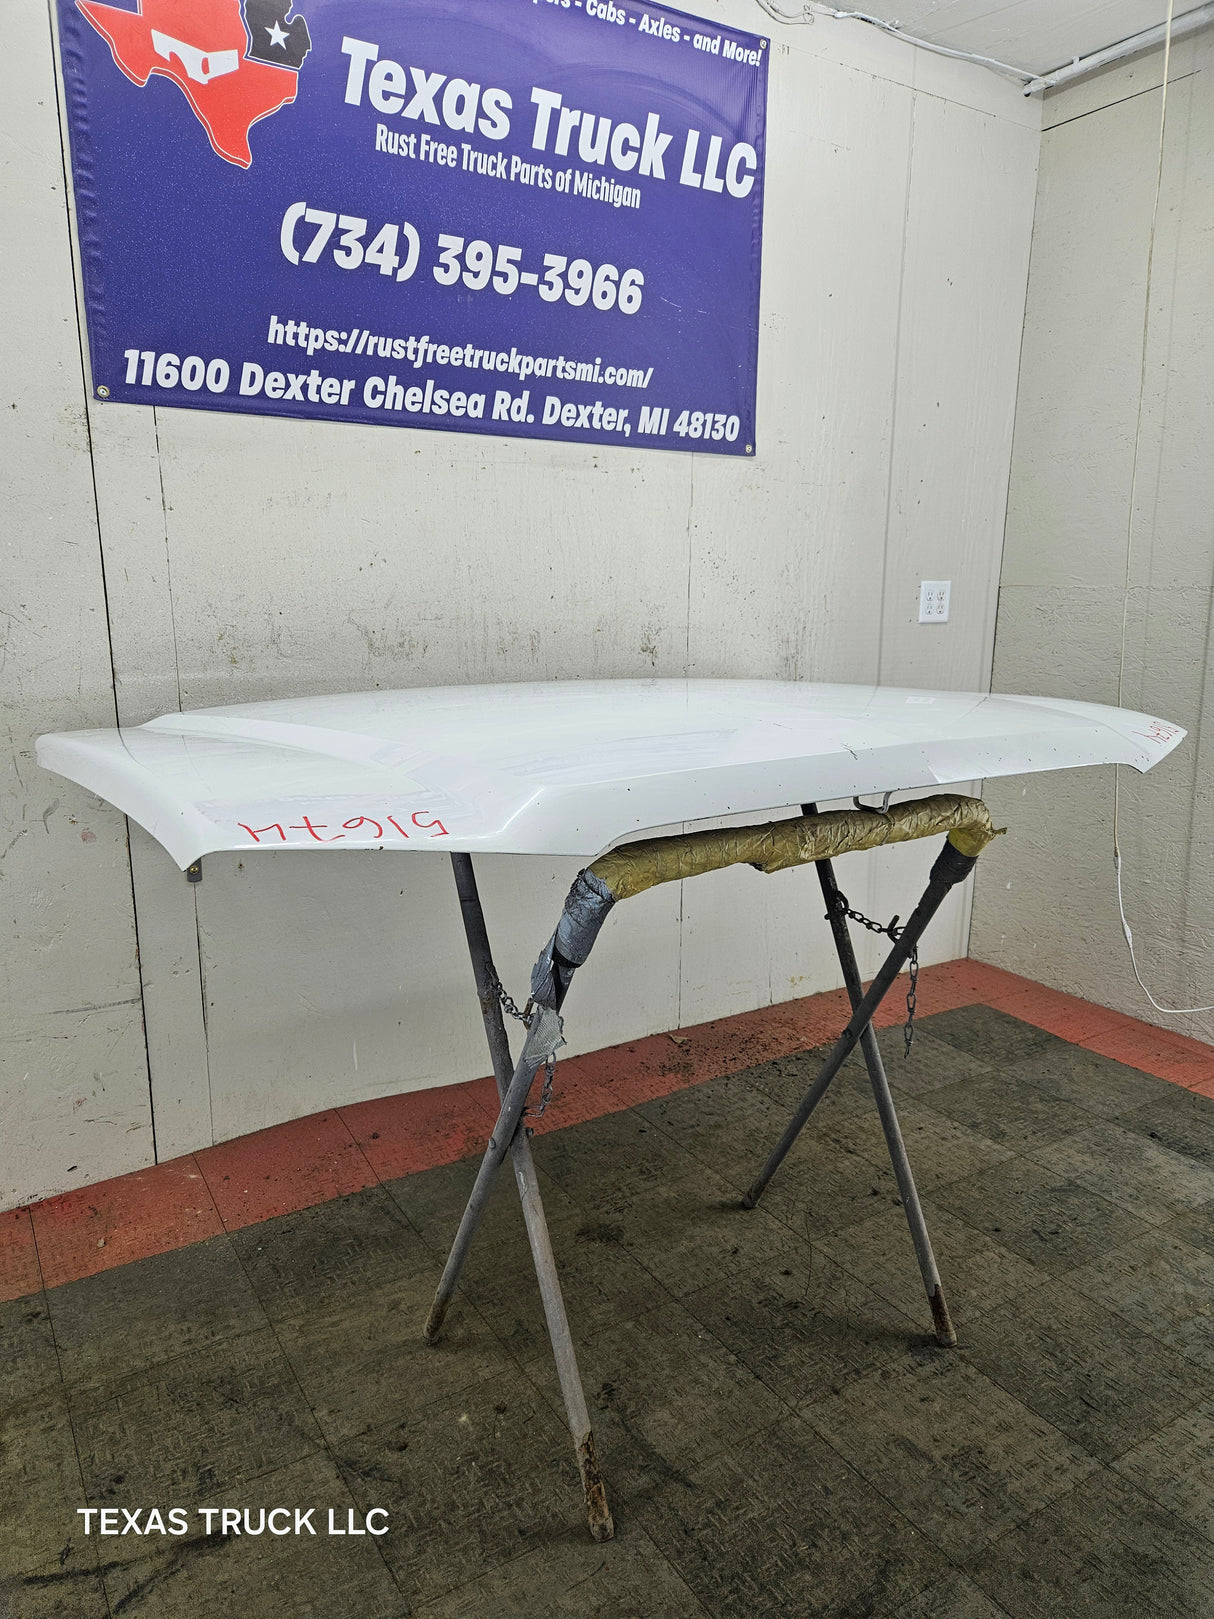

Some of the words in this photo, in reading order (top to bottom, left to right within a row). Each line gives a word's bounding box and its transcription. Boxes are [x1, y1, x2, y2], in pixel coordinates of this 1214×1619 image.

[585, 0, 626, 25] Cabs
[638, 14, 681, 42] Axles
[693, 34, 722, 55] and
[722, 39, 762, 67] More!
[341, 36, 513, 140] Texas
[530, 87, 674, 180] Truck
[679, 128, 757, 198] LLC
[375, 123, 417, 159] Rust
[419, 133, 458, 168] Free
[461, 143, 508, 180] Truck
[510, 155, 553, 190] Parts
[555, 169, 573, 194] of
[573, 171, 641, 209] Michigan
[280, 201, 420, 282] (734)
[432, 233, 645, 315] 395-3966
[123, 349, 230, 393] 11600
[239, 362, 356, 405] Dexter
[363, 376, 486, 418] Chelsea
[491, 390, 535, 424] Rd.
[541, 395, 631, 437] Dexter,
[637, 405, 670, 436] MI
[672, 410, 740, 442] 48130
[267, 315, 654, 389] https://rustfreetruckpartsmi.com/
